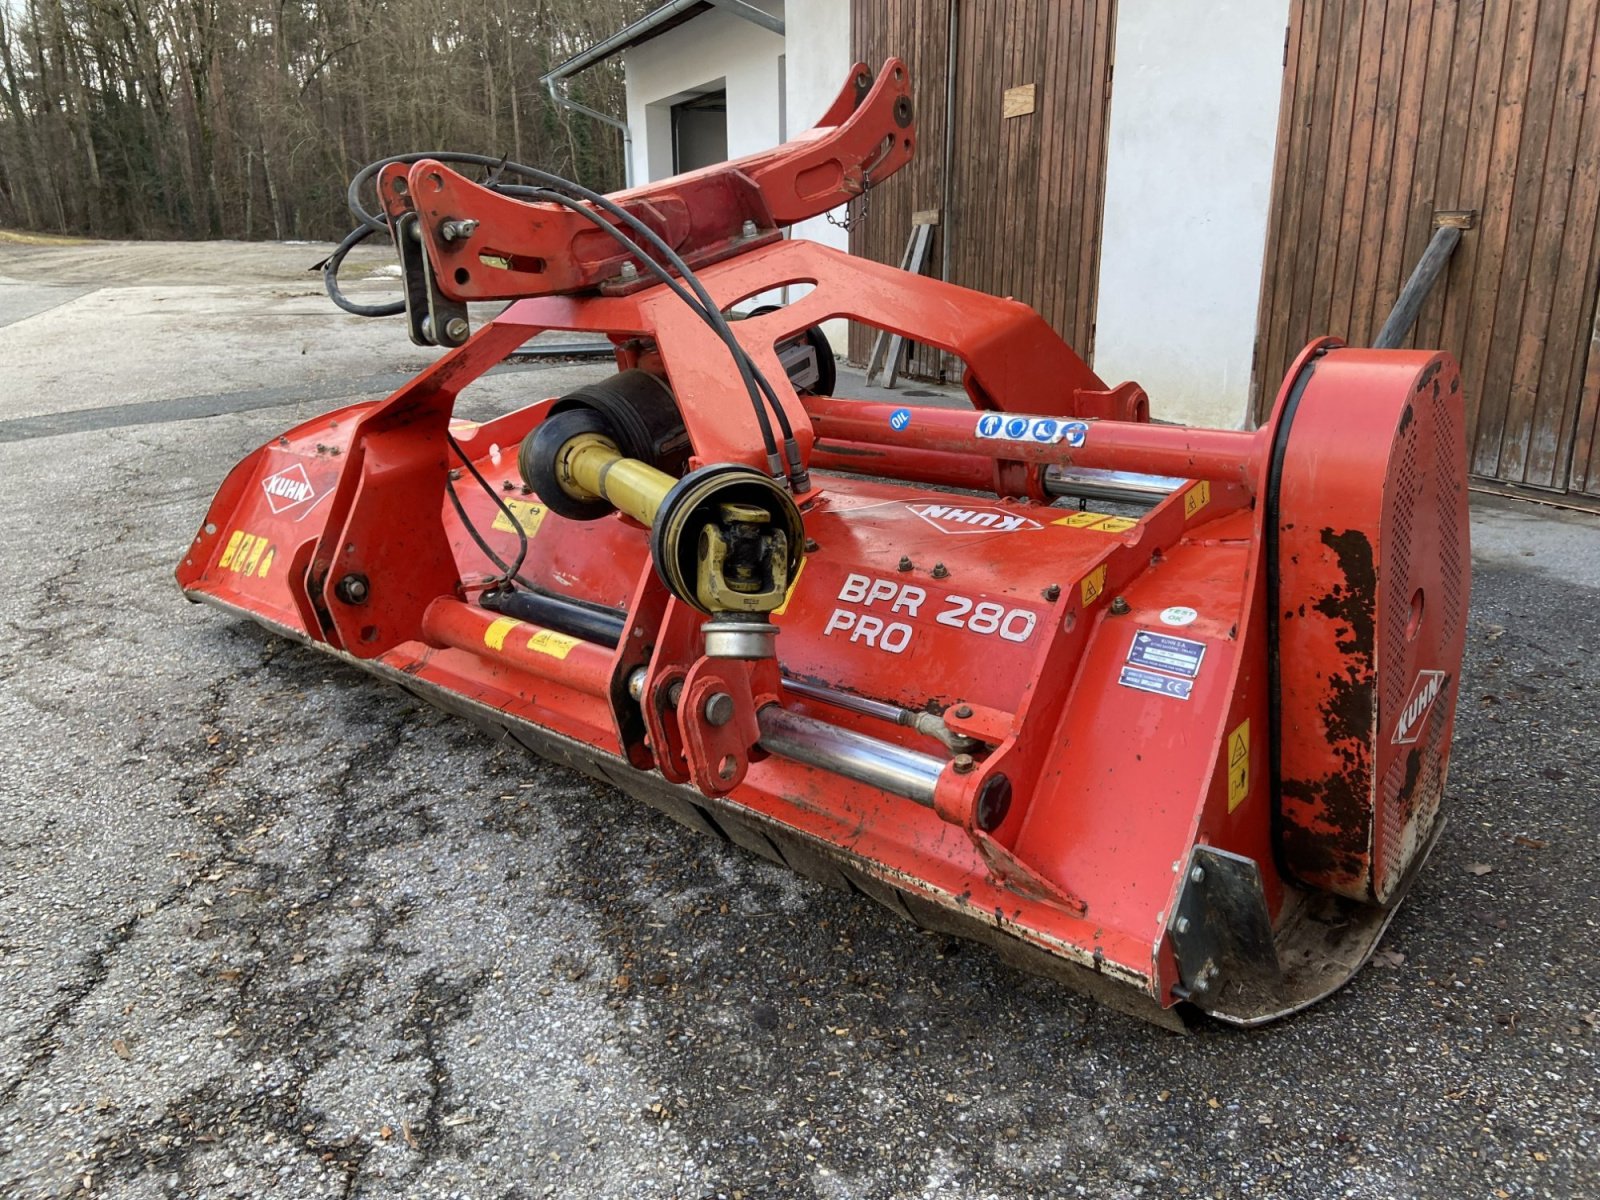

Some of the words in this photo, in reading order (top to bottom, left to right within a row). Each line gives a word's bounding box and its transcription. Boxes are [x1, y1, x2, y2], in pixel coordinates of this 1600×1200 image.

[891, 411, 909, 429] OIL
[267, 475, 309, 502] KUHN
[919, 505, 1026, 530] KUHN
[837, 573, 927, 617] BPR
[935, 594, 1037, 643] 280
[1168, 608, 1195, 616] TEST
[823, 608, 913, 654] PRO
[1167, 681, 1182, 693] CE
[1398, 673, 1438, 741] KUHN
